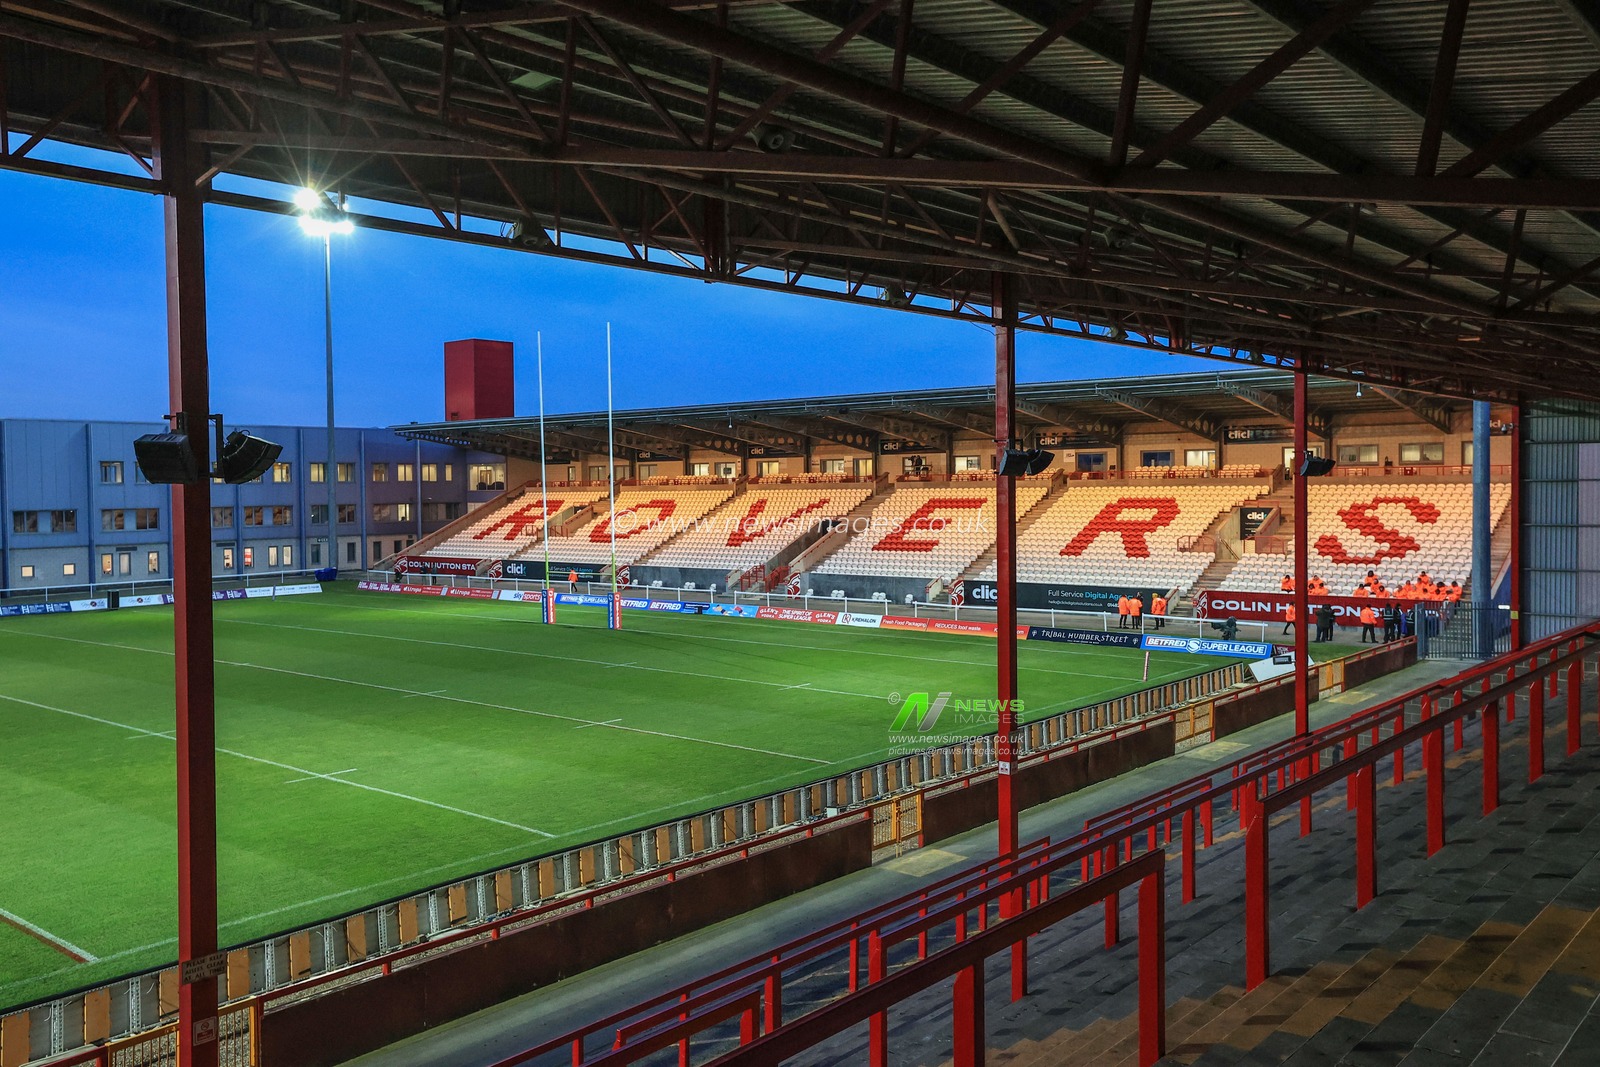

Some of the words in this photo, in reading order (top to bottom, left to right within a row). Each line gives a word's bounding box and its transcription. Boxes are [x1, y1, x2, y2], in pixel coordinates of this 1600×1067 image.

[972, 584, 998, 600] clic
[1048, 589, 1060, 597] Full
[1060, 590, 1084, 599] Service
[1084, 591, 1108, 601] Digital
[649, 600, 682, 611] BETFRED
[1211, 599, 1271, 612] COLIN
[882, 618, 894, 626] Fresh
[934, 622, 958, 630] REDUCES
[1041, 629, 1066, 639] TRIBAL
[1067, 632, 1101, 642] HUMBER
[1100, 633, 1129, 643] STREET
[1147, 637, 1187, 647] BETFRED
[1202, 641, 1228, 651] SUPER
[1228, 644, 1265, 655] LEAGUE
